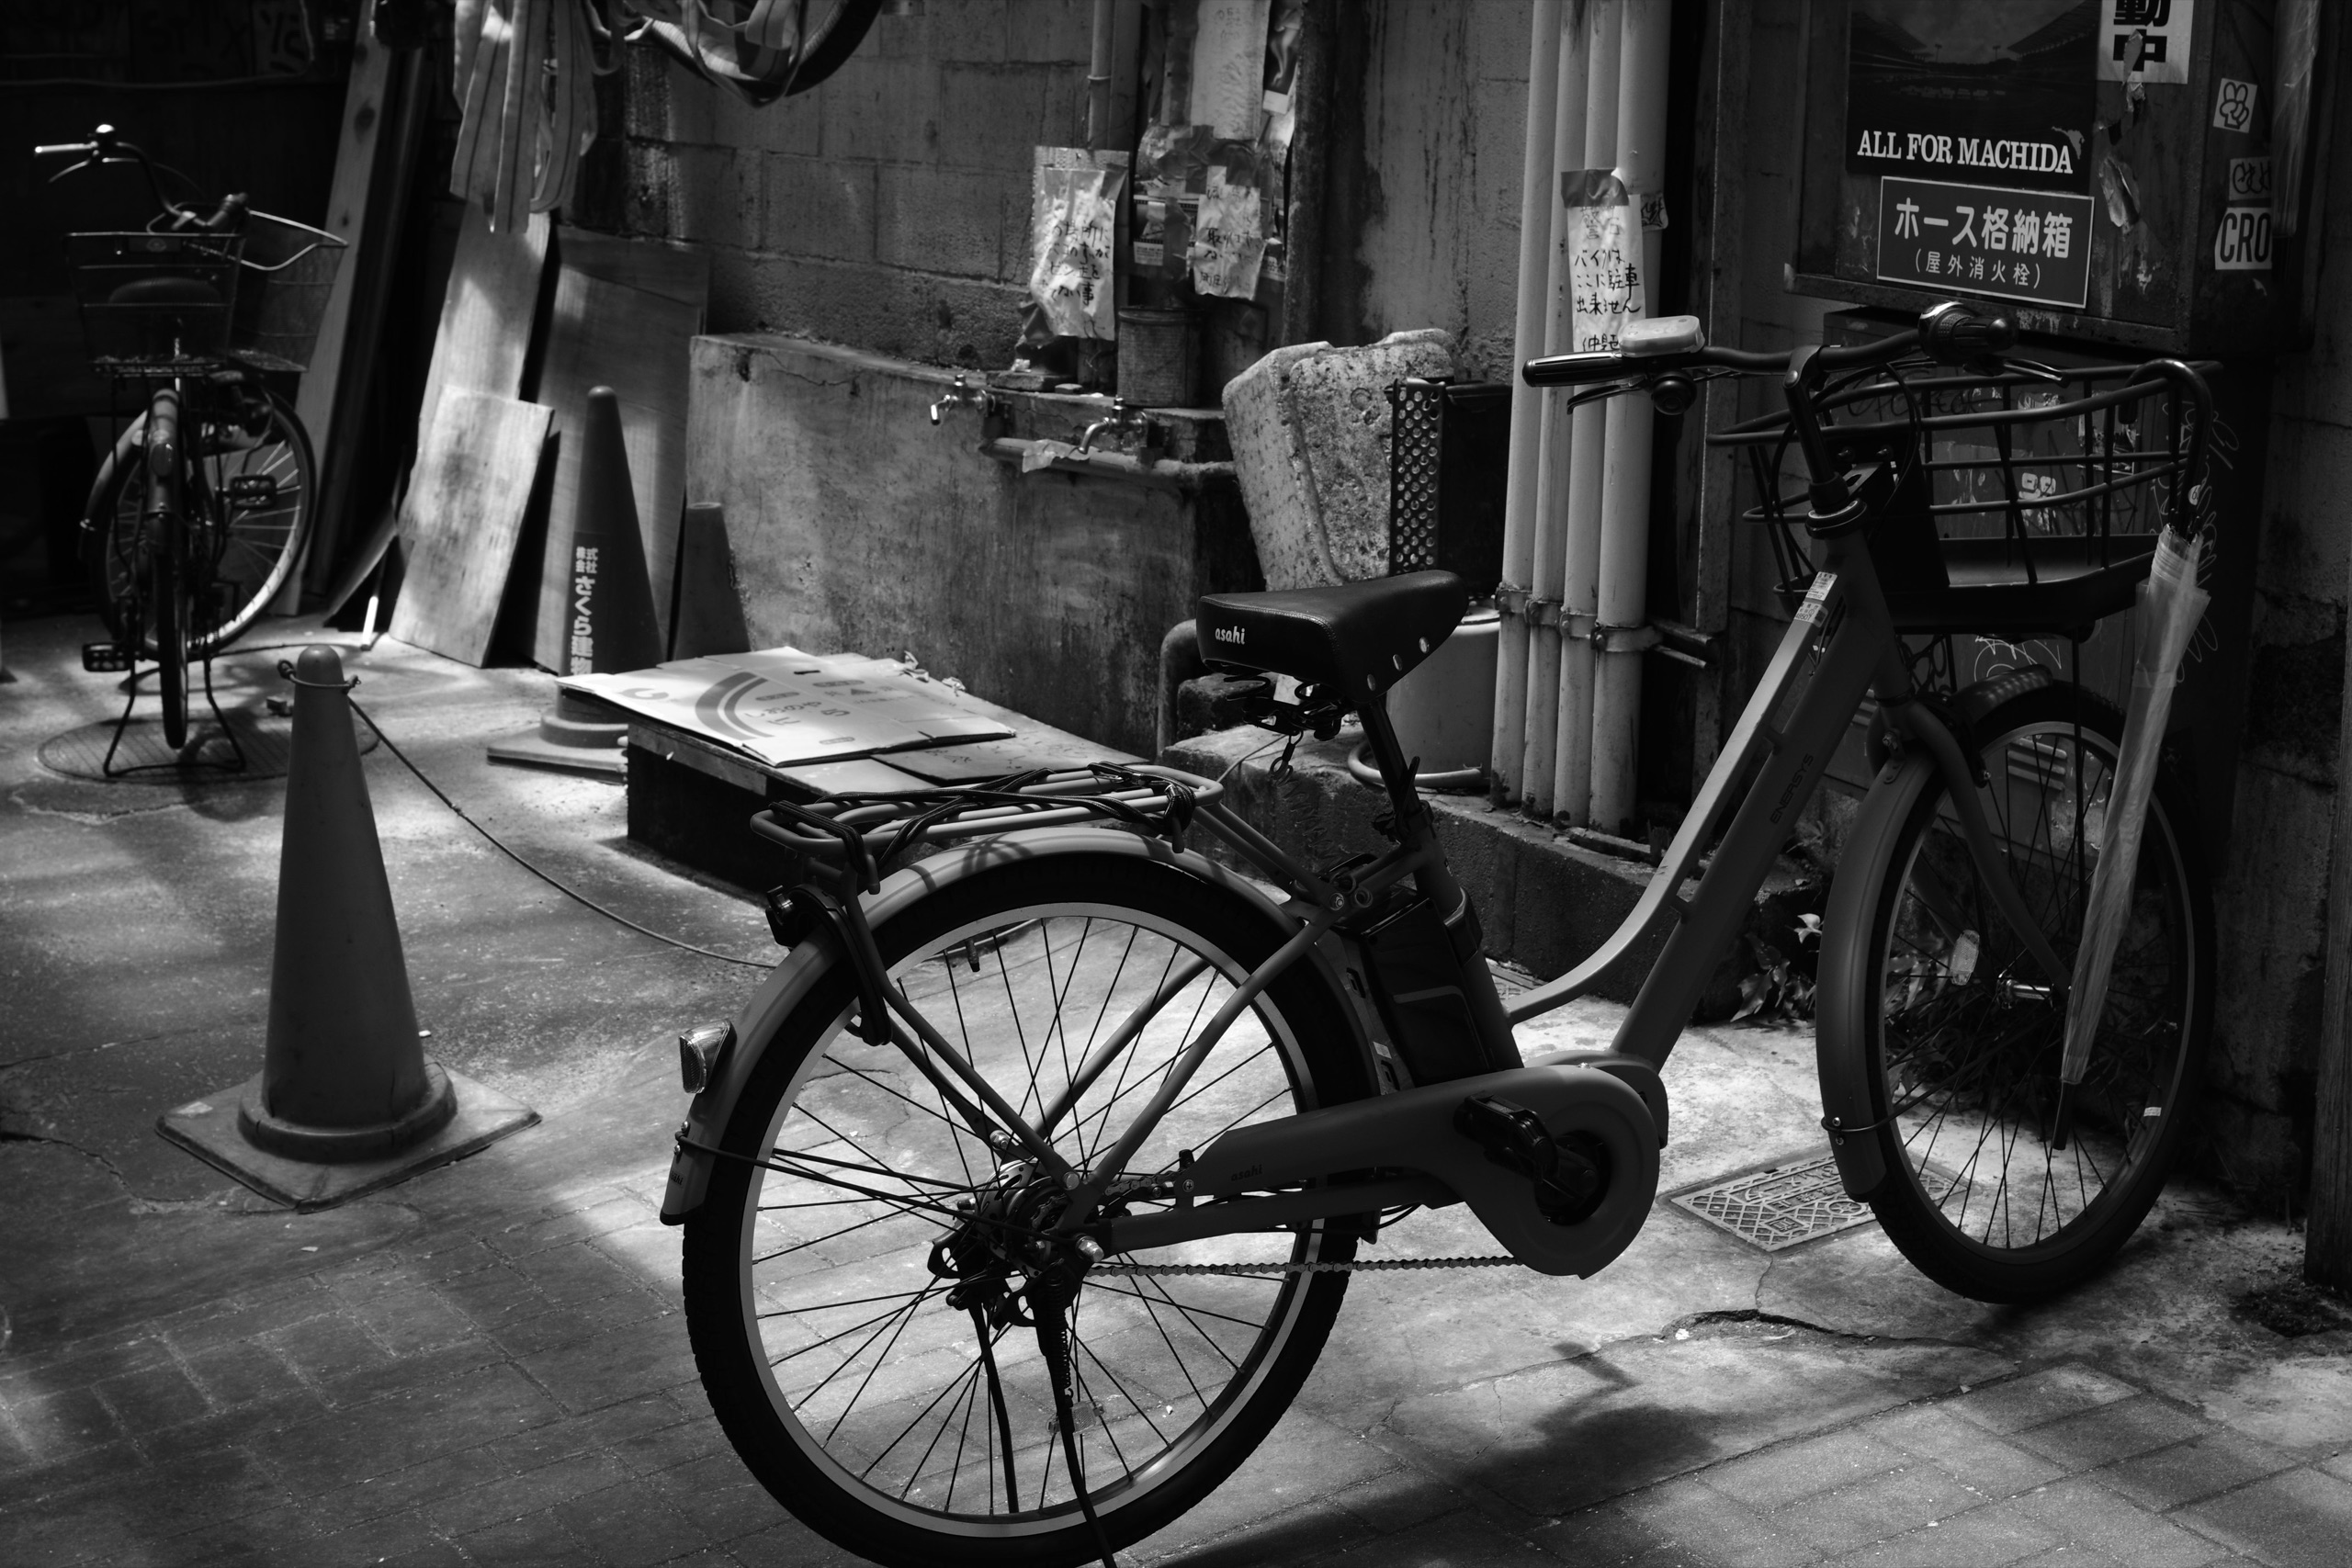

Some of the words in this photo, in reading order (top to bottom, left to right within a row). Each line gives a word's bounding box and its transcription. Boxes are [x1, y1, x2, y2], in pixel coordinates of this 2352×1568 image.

[1857, 130, 1902, 159] ALL
[1906, 133, 1953, 164] FOR
[1957, 137, 2074, 175] MACHIDA
[1894, 197, 2074, 259] ホース格納箱
[1215, 626, 1246, 645] asahi
[1770, 753, 1814, 824] ENERSYS
[1231, 1164, 1263, 1182] asahi
